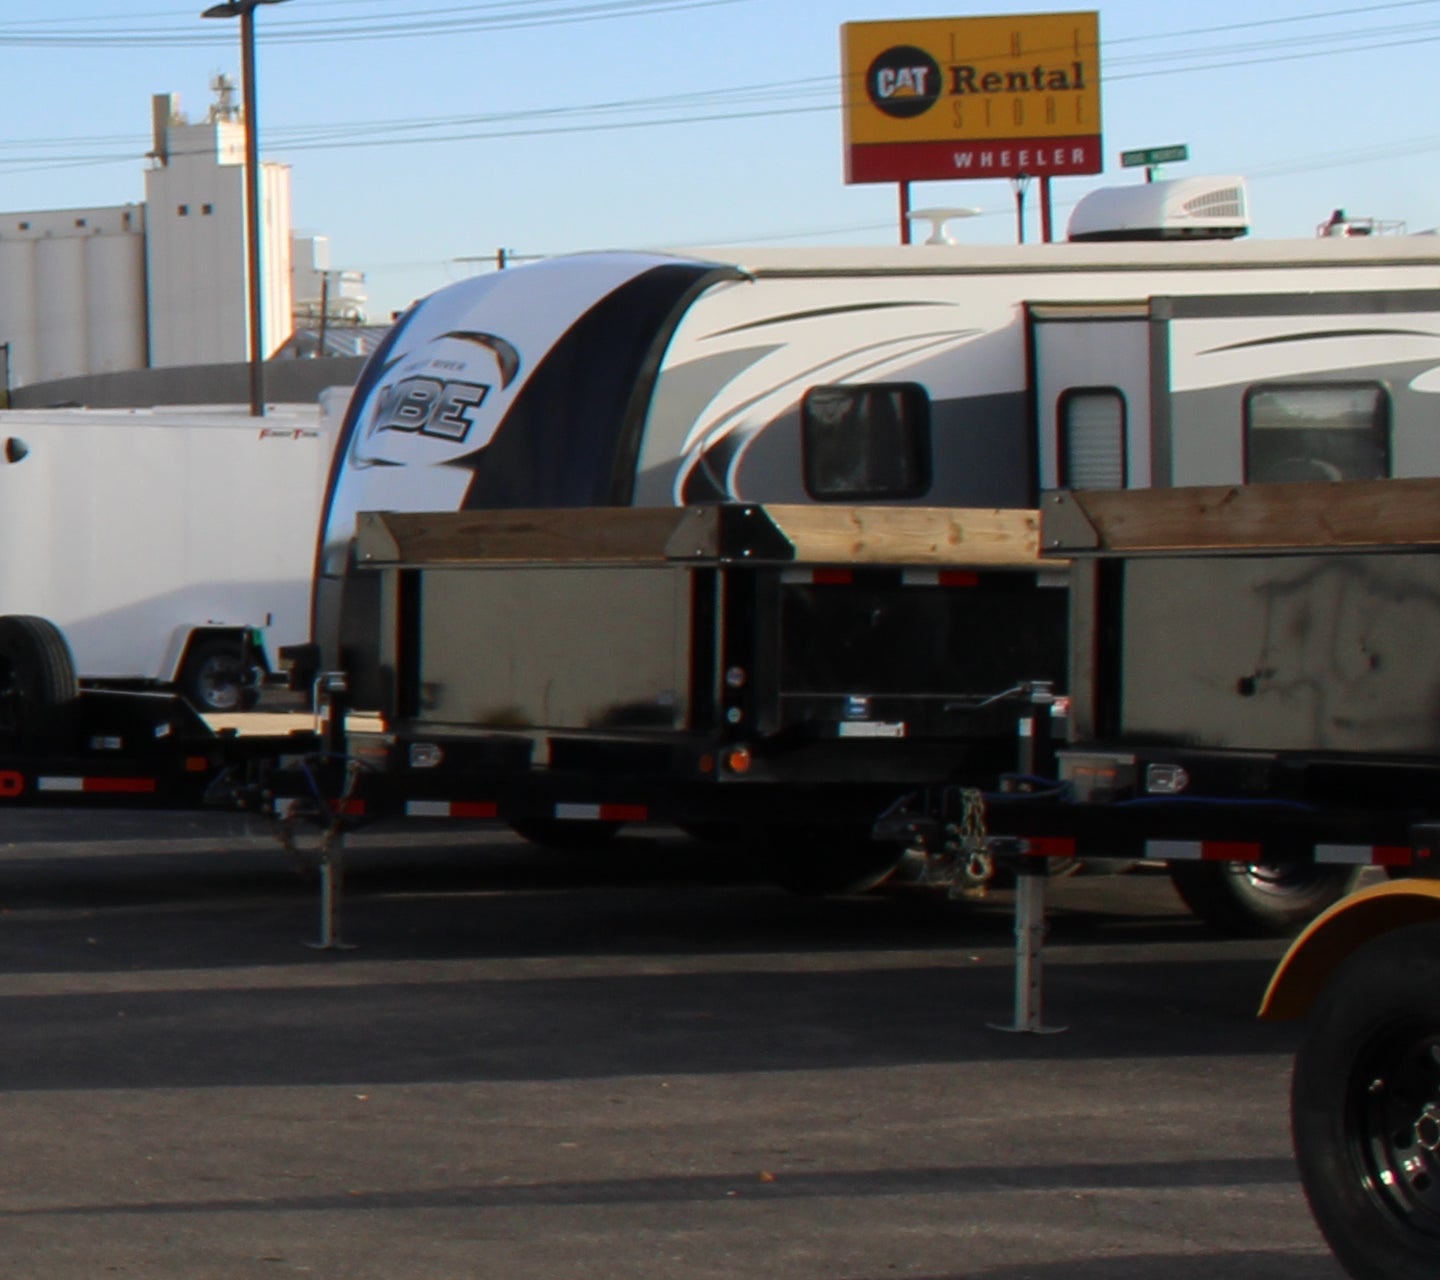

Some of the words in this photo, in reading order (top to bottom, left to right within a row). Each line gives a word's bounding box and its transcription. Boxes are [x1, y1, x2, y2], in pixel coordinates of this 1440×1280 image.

[877, 65, 930, 98] CAT
[949, 61, 1085, 95] Rental
[953, 95, 1089, 129] STORE
[954, 148, 1085, 168] WHEELER
